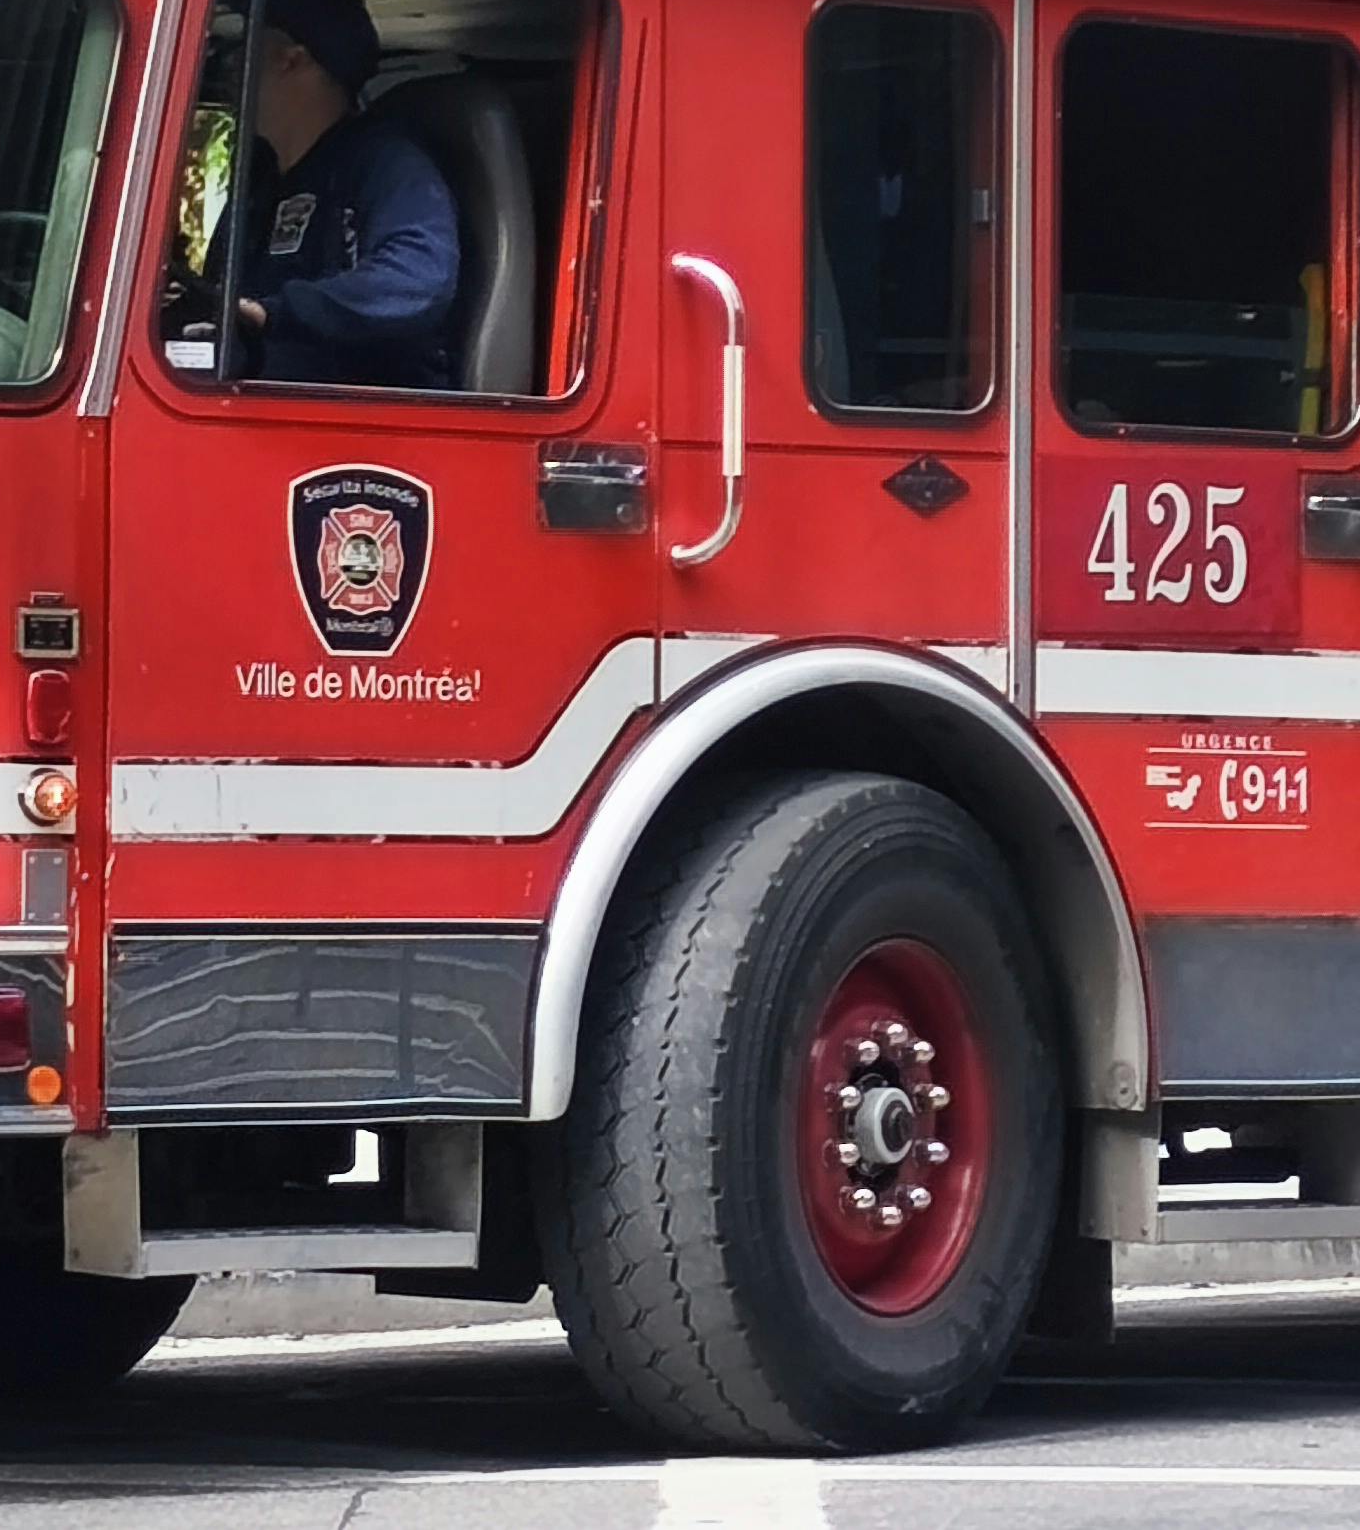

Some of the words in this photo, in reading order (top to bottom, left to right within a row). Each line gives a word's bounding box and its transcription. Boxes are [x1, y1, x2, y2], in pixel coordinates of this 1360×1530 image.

[1087, 482, 1248, 604] 425
[235, 661, 296, 698] Ville
[304, 664, 343, 699] de
[350, 664, 482, 702] Montréal
[1181, 733, 1273, 751] URGENCE
[1242, 764, 1308, 814] 9-1-1
